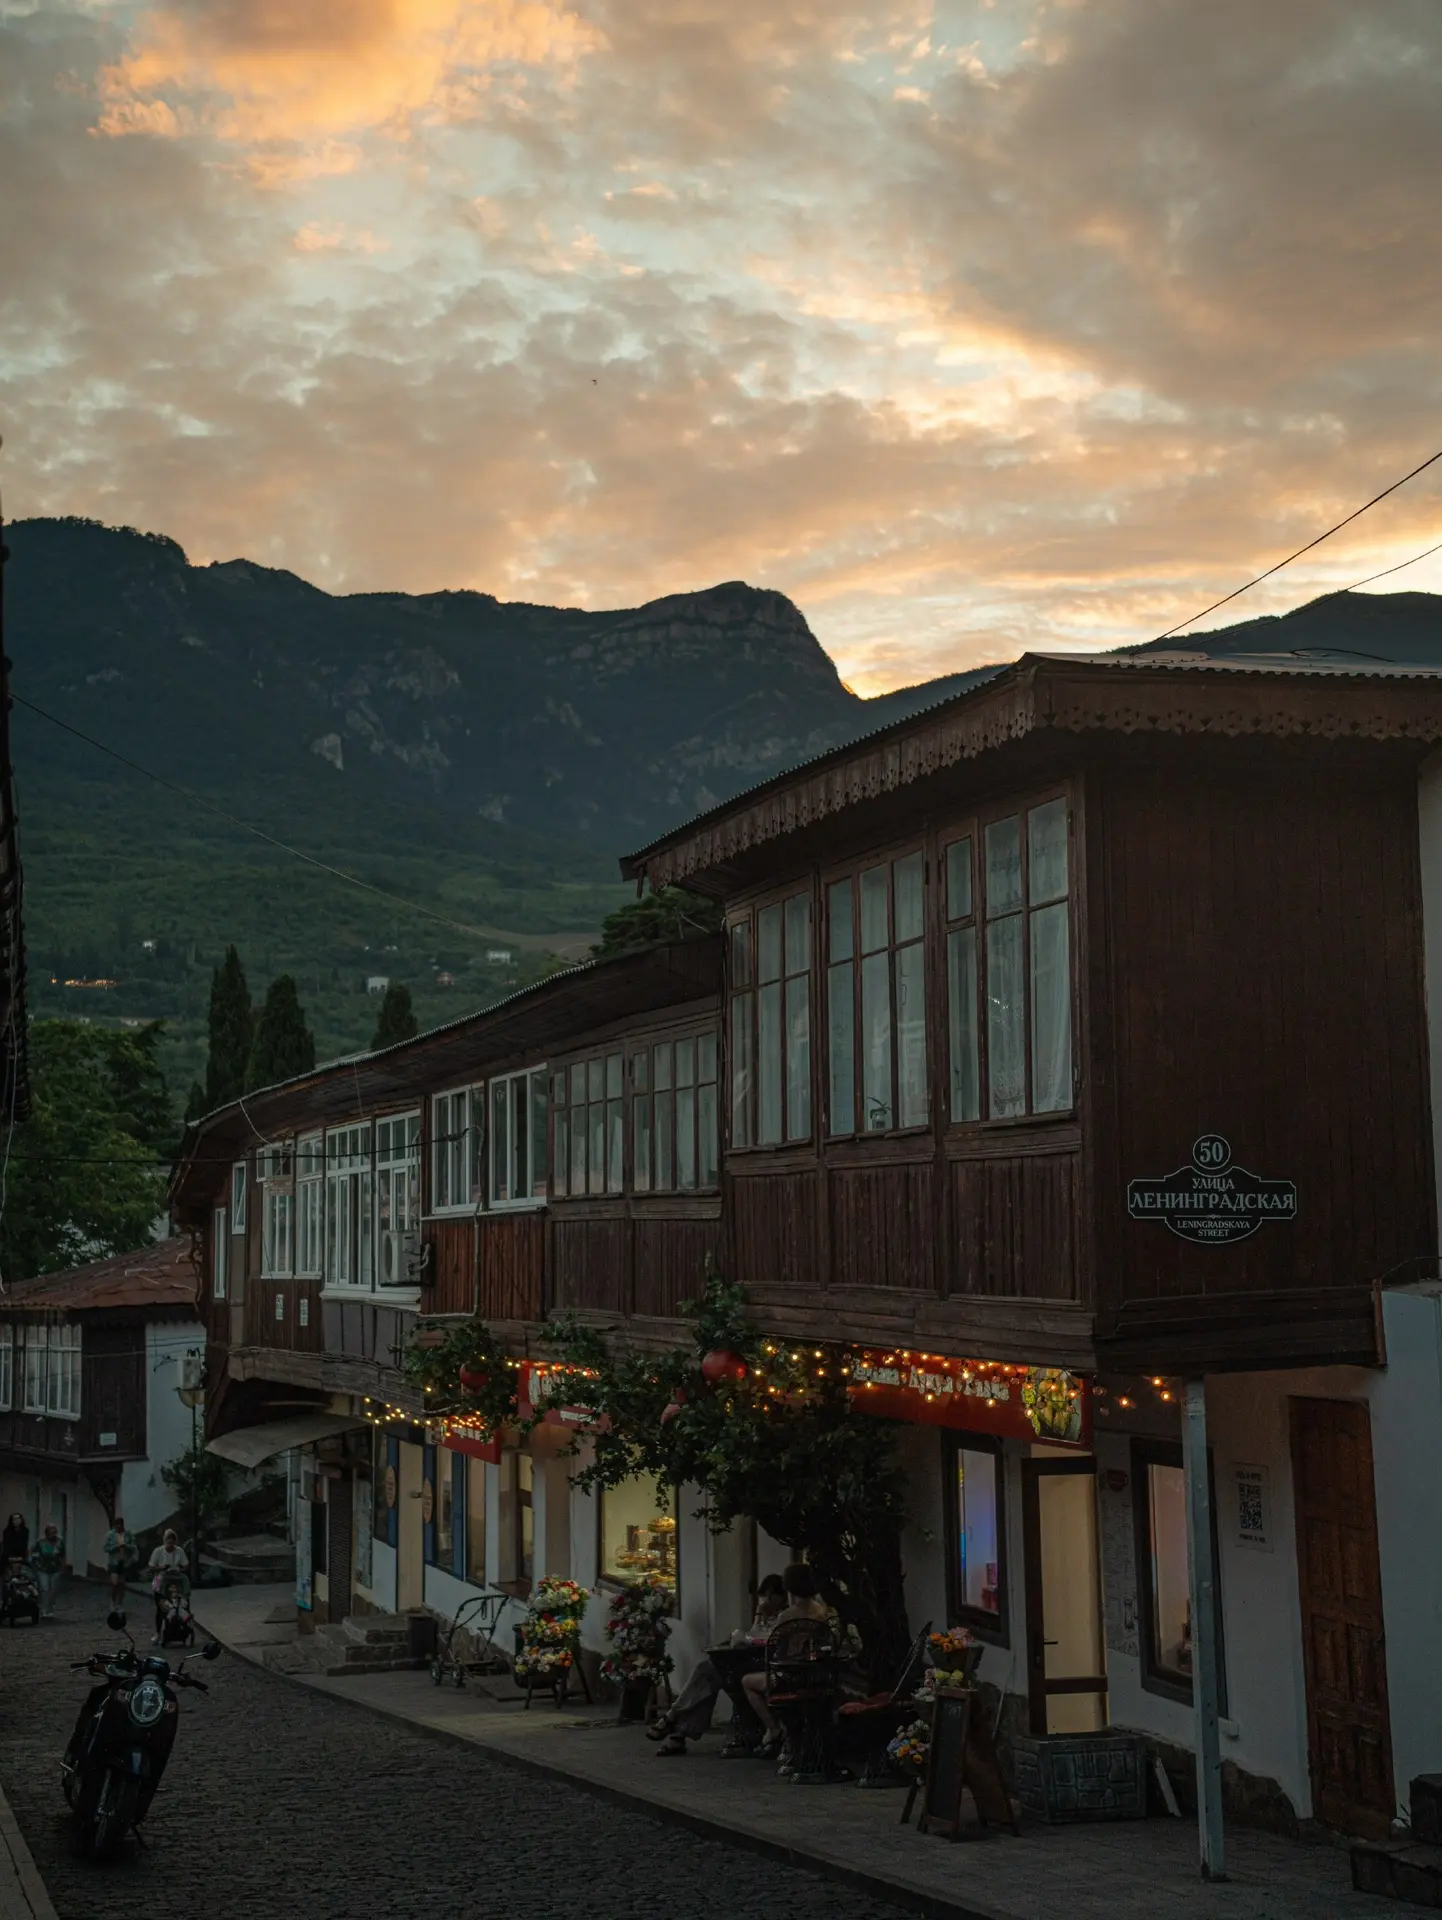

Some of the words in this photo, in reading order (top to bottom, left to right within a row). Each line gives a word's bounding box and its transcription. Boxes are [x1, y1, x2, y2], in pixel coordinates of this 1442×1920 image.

[1199, 1141, 1224, 1163] 50
[1191, 1177, 1235, 1192] УЛИЦА
[1130, 1192, 1294, 1212] ЛЕНИНГРАДСКАЯ
[1177, 1220, 1250, 1229] LENINGRADSKAYA
[1198, 1229, 1230, 1237] STREET
